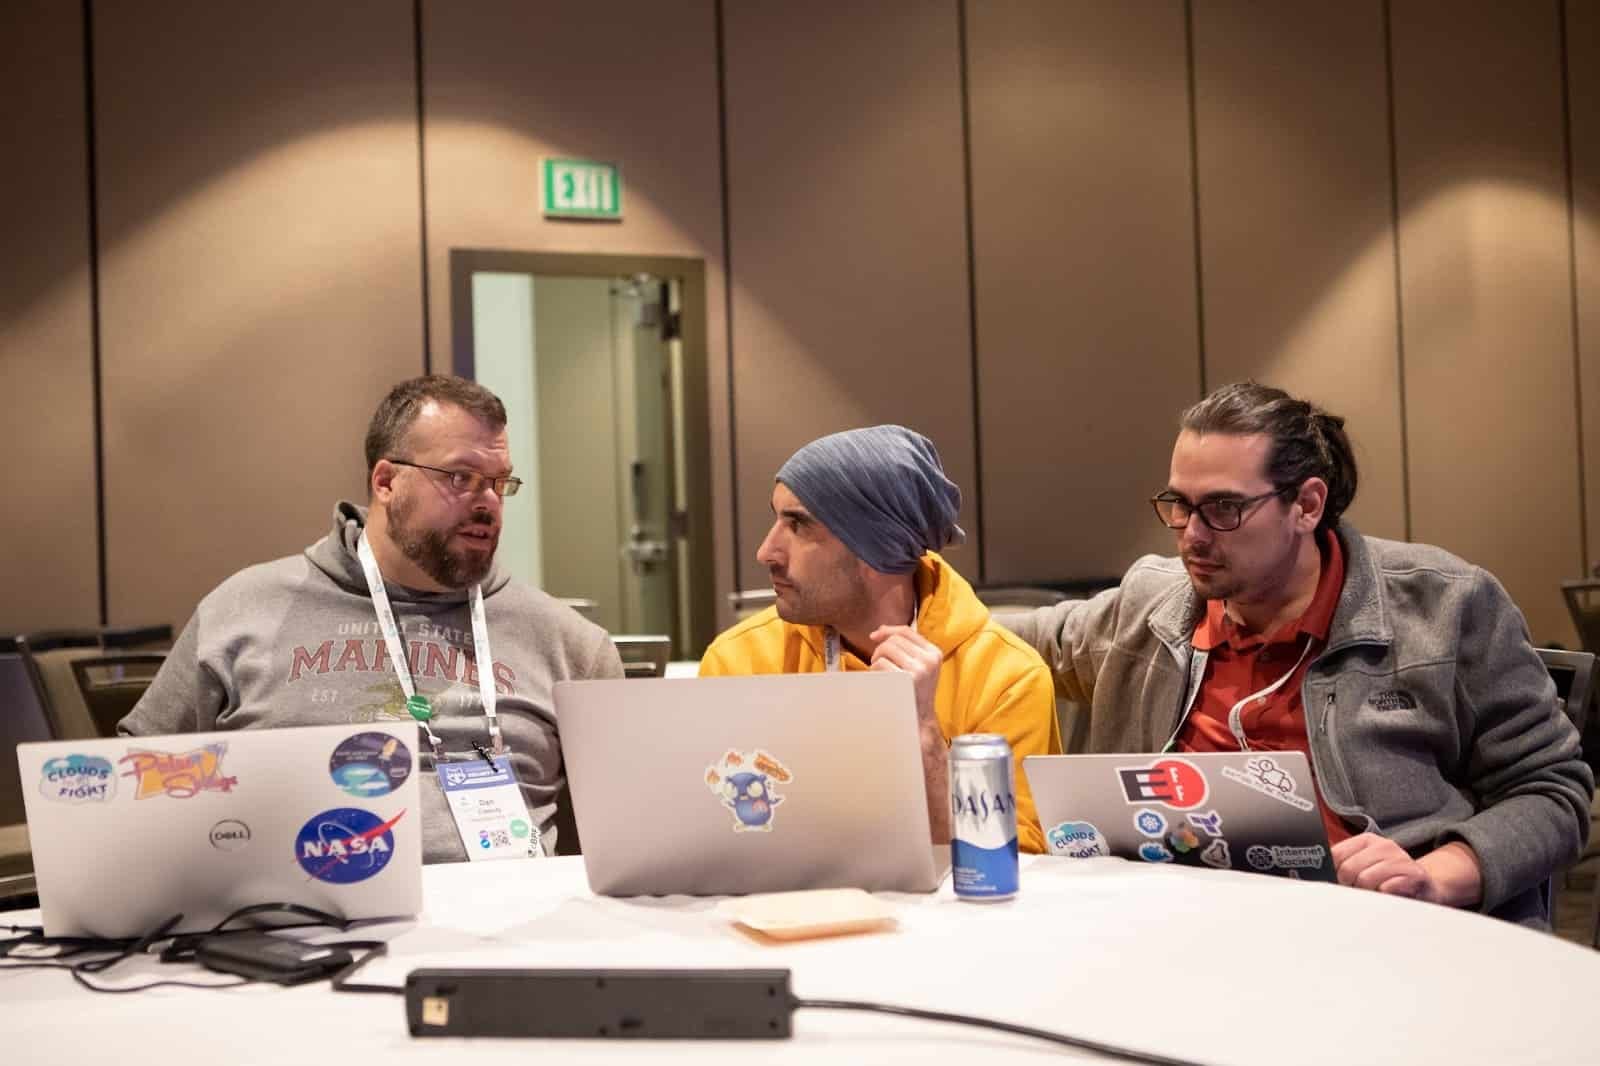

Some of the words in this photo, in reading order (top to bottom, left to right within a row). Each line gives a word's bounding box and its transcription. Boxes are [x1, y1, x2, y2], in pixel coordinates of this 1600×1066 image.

[553, 166, 612, 209] EXIT
[338, 621, 408, 636] UNIT
[418, 623, 474, 645] STATE
[48, 767, 109, 782] CLOUDS
[59, 784, 108, 798] FIGHT
[215, 829, 245, 841] DELL
[1055, 831, 1096, 849] CLOUDS
[303, 835, 390, 858] NASA
[1274, 847, 1323, 856] Internet
[1277, 857, 1320, 868] Society
